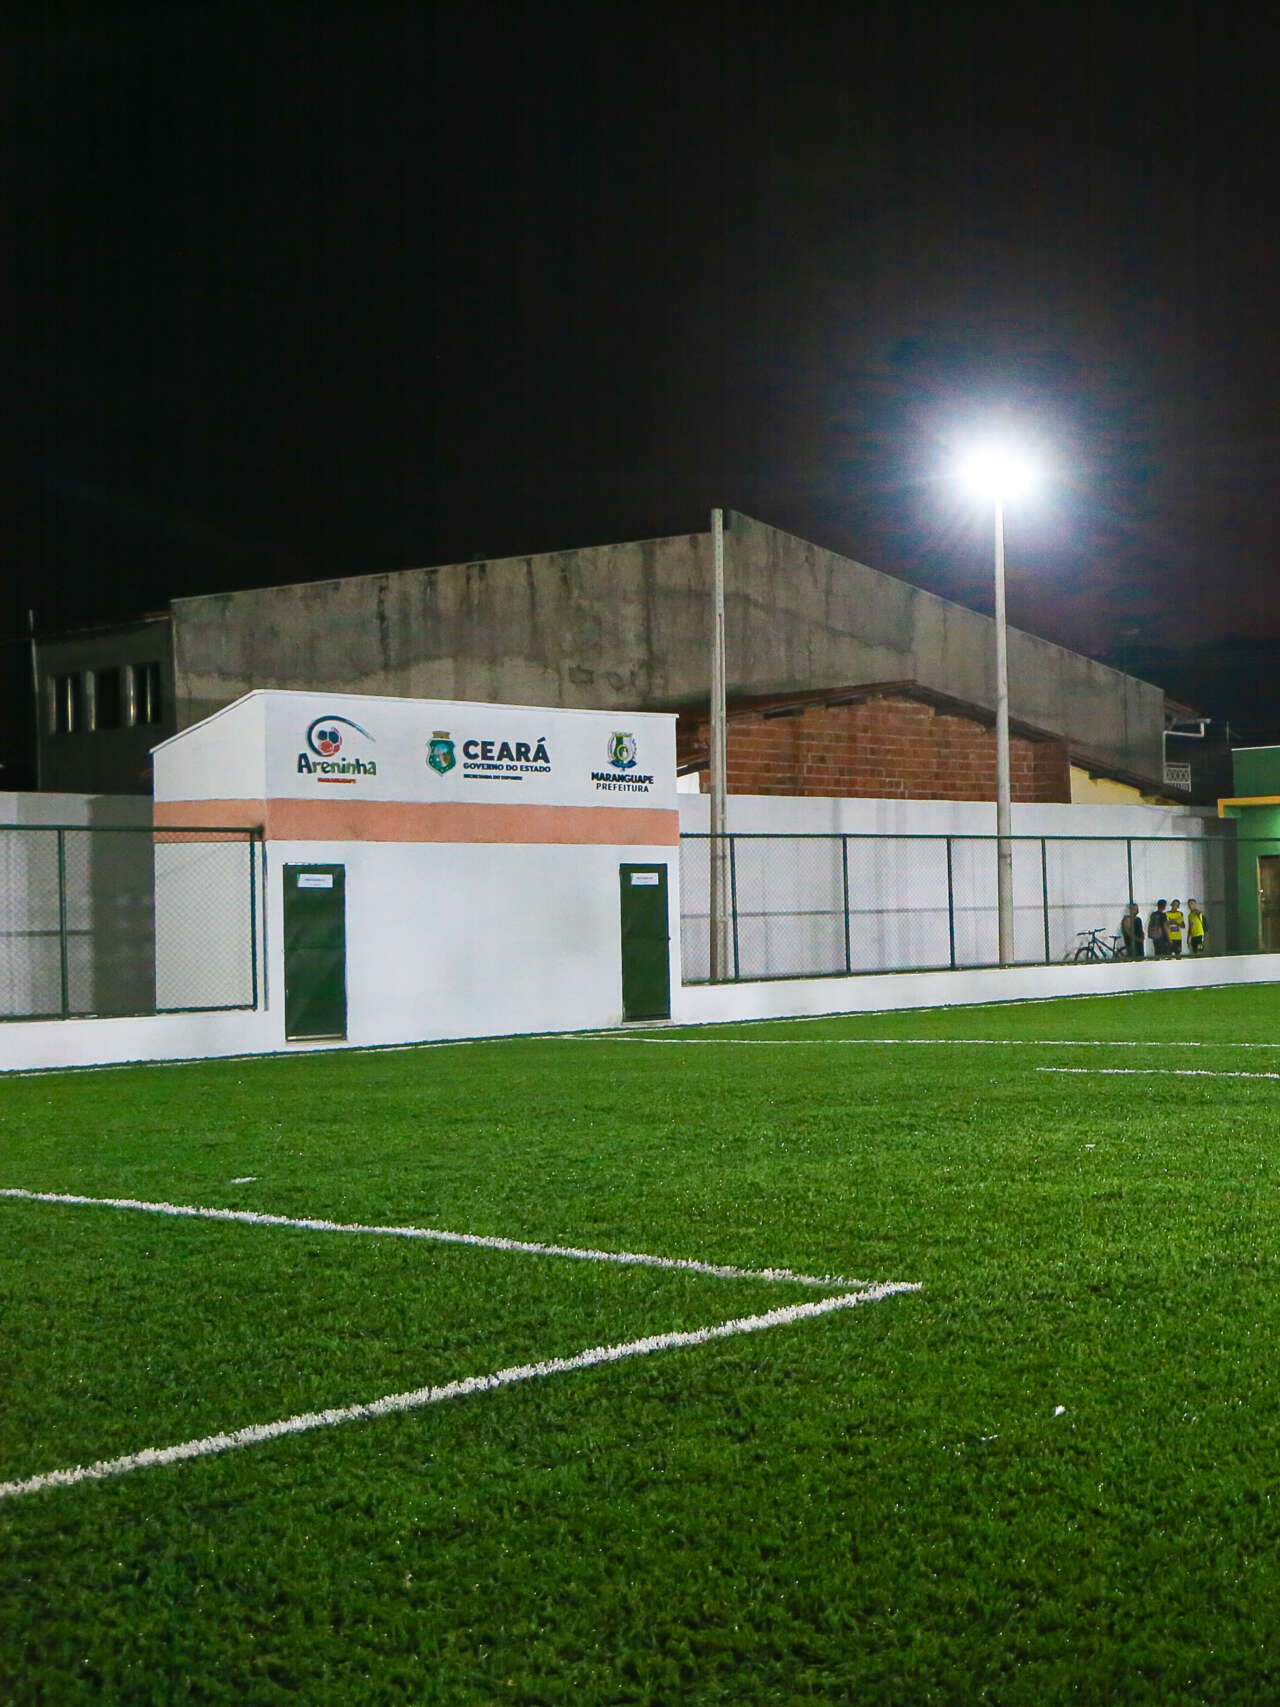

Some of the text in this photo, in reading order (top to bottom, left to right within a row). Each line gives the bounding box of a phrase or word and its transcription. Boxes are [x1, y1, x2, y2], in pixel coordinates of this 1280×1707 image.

[463, 736, 550, 764] CEARÁ
[297, 752, 377, 776] Areninha
[463, 762, 551, 773] GOVERNO DO ESTADO
[591, 771, 655, 785] MARANGUAPE
[596, 782, 649, 793] PREFEITURA
